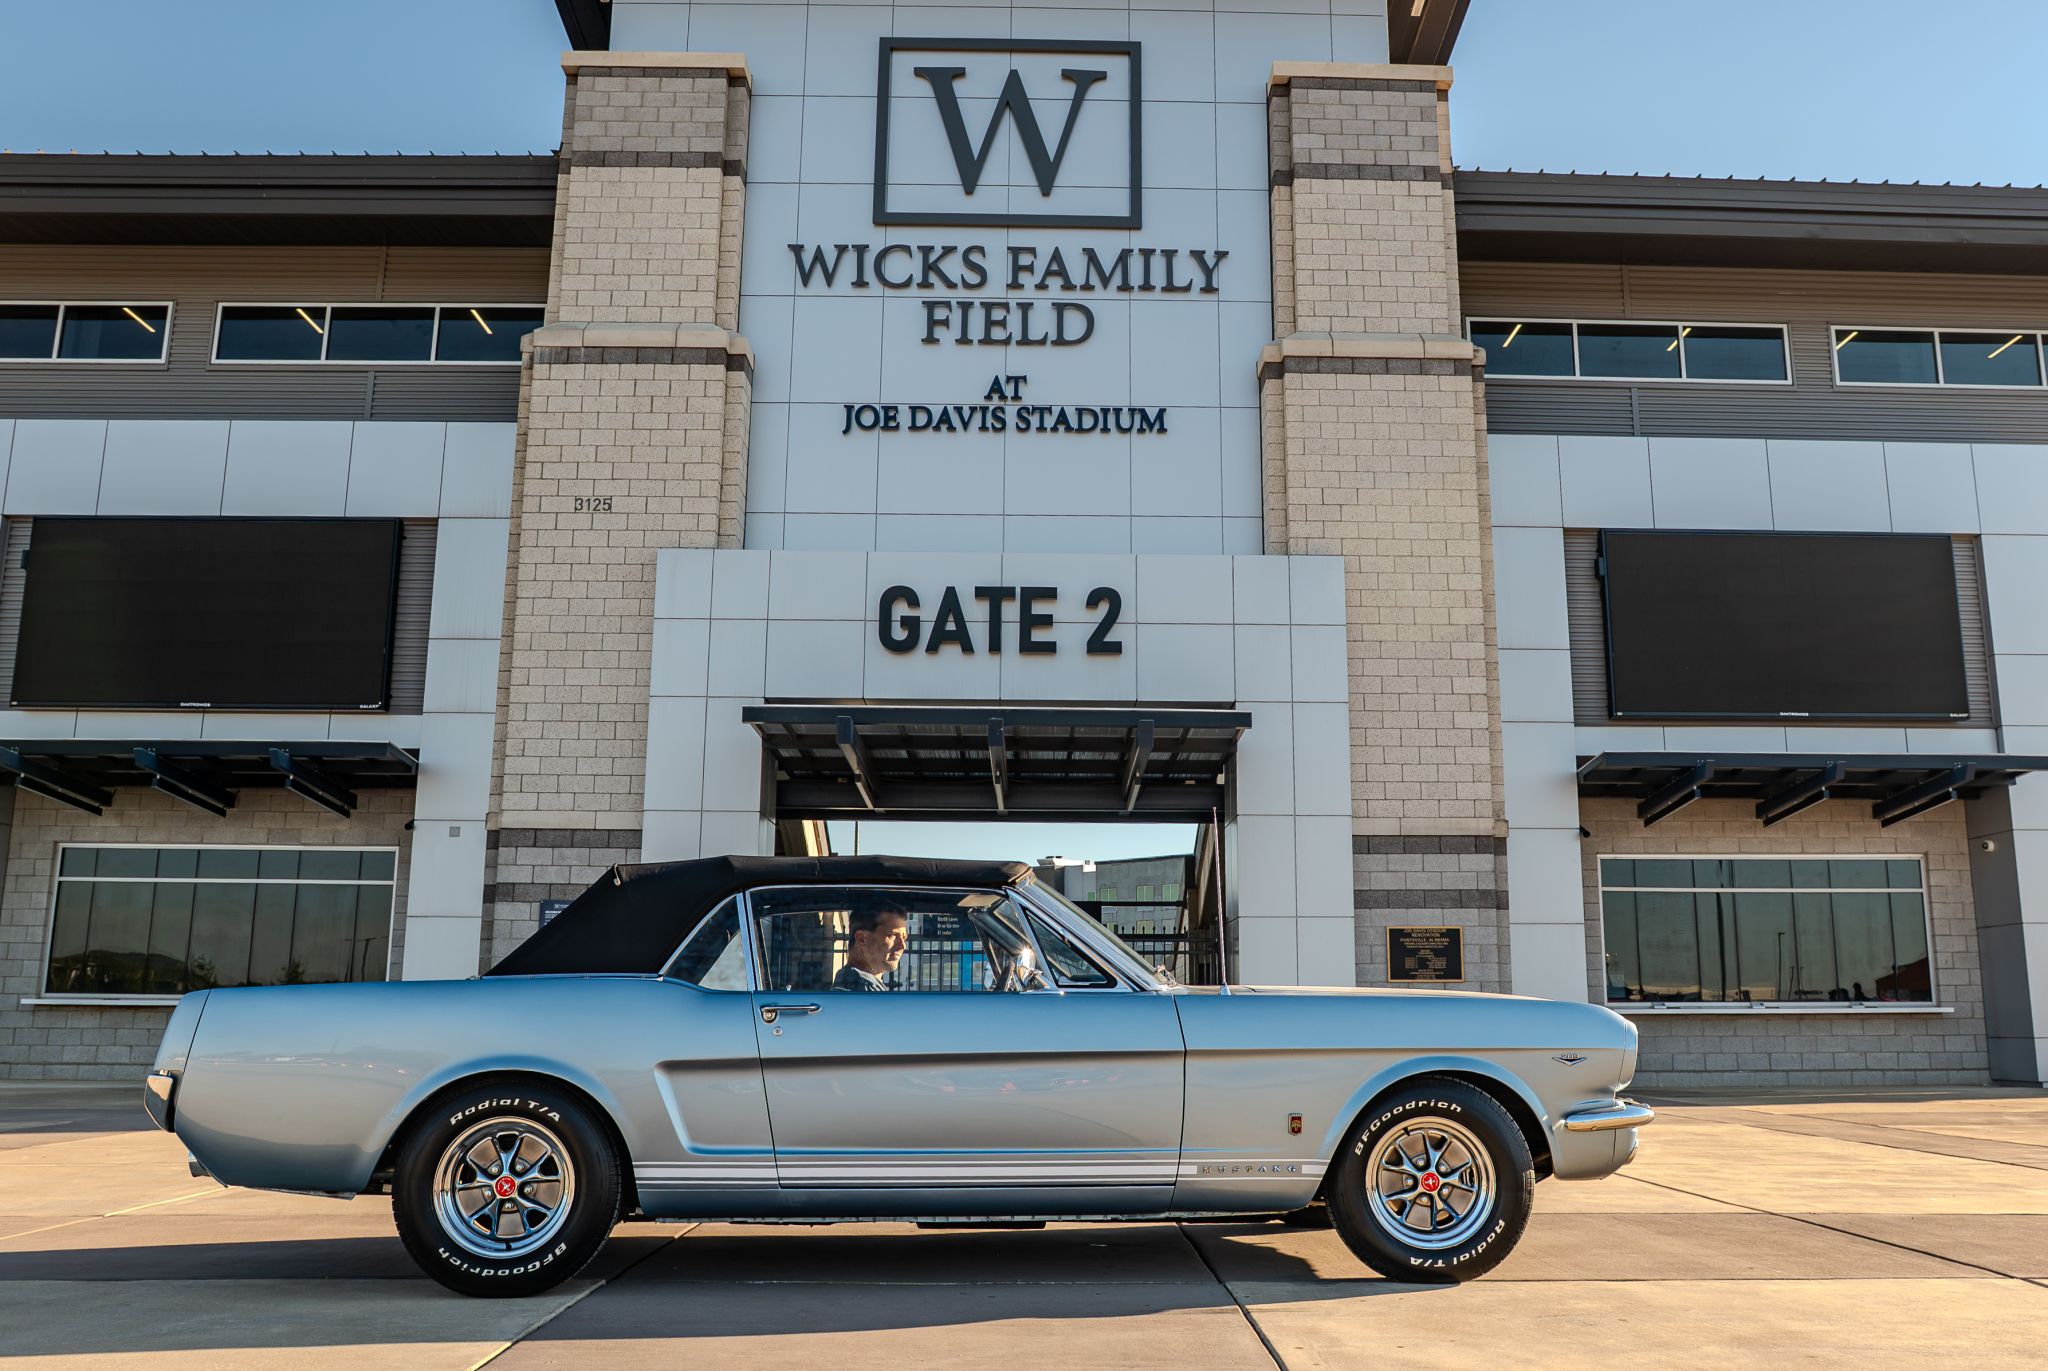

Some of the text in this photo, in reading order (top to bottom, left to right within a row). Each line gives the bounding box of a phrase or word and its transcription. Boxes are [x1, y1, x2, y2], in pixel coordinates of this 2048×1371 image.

[913, 66, 1107, 196] W
[787, 243, 1229, 292] WICKS FAMILY
[921, 300, 1096, 346] FIELD
[984, 374, 1028, 401] AT
[842, 404, 1168, 435] JOE DAVIS STADIUM
[575, 497, 611, 511] 3125
[878, 585, 1123, 655] GATE 2
[450, 1098, 561, 1126] Radial T/A
[1354, 1099, 1463, 1157] BFGoodrich
[1202, 1165, 1297, 1174] MUSTANG
[438, 1242, 568, 1277] BFGoodrich
[1410, 1218, 1506, 1268] Radial T/A
